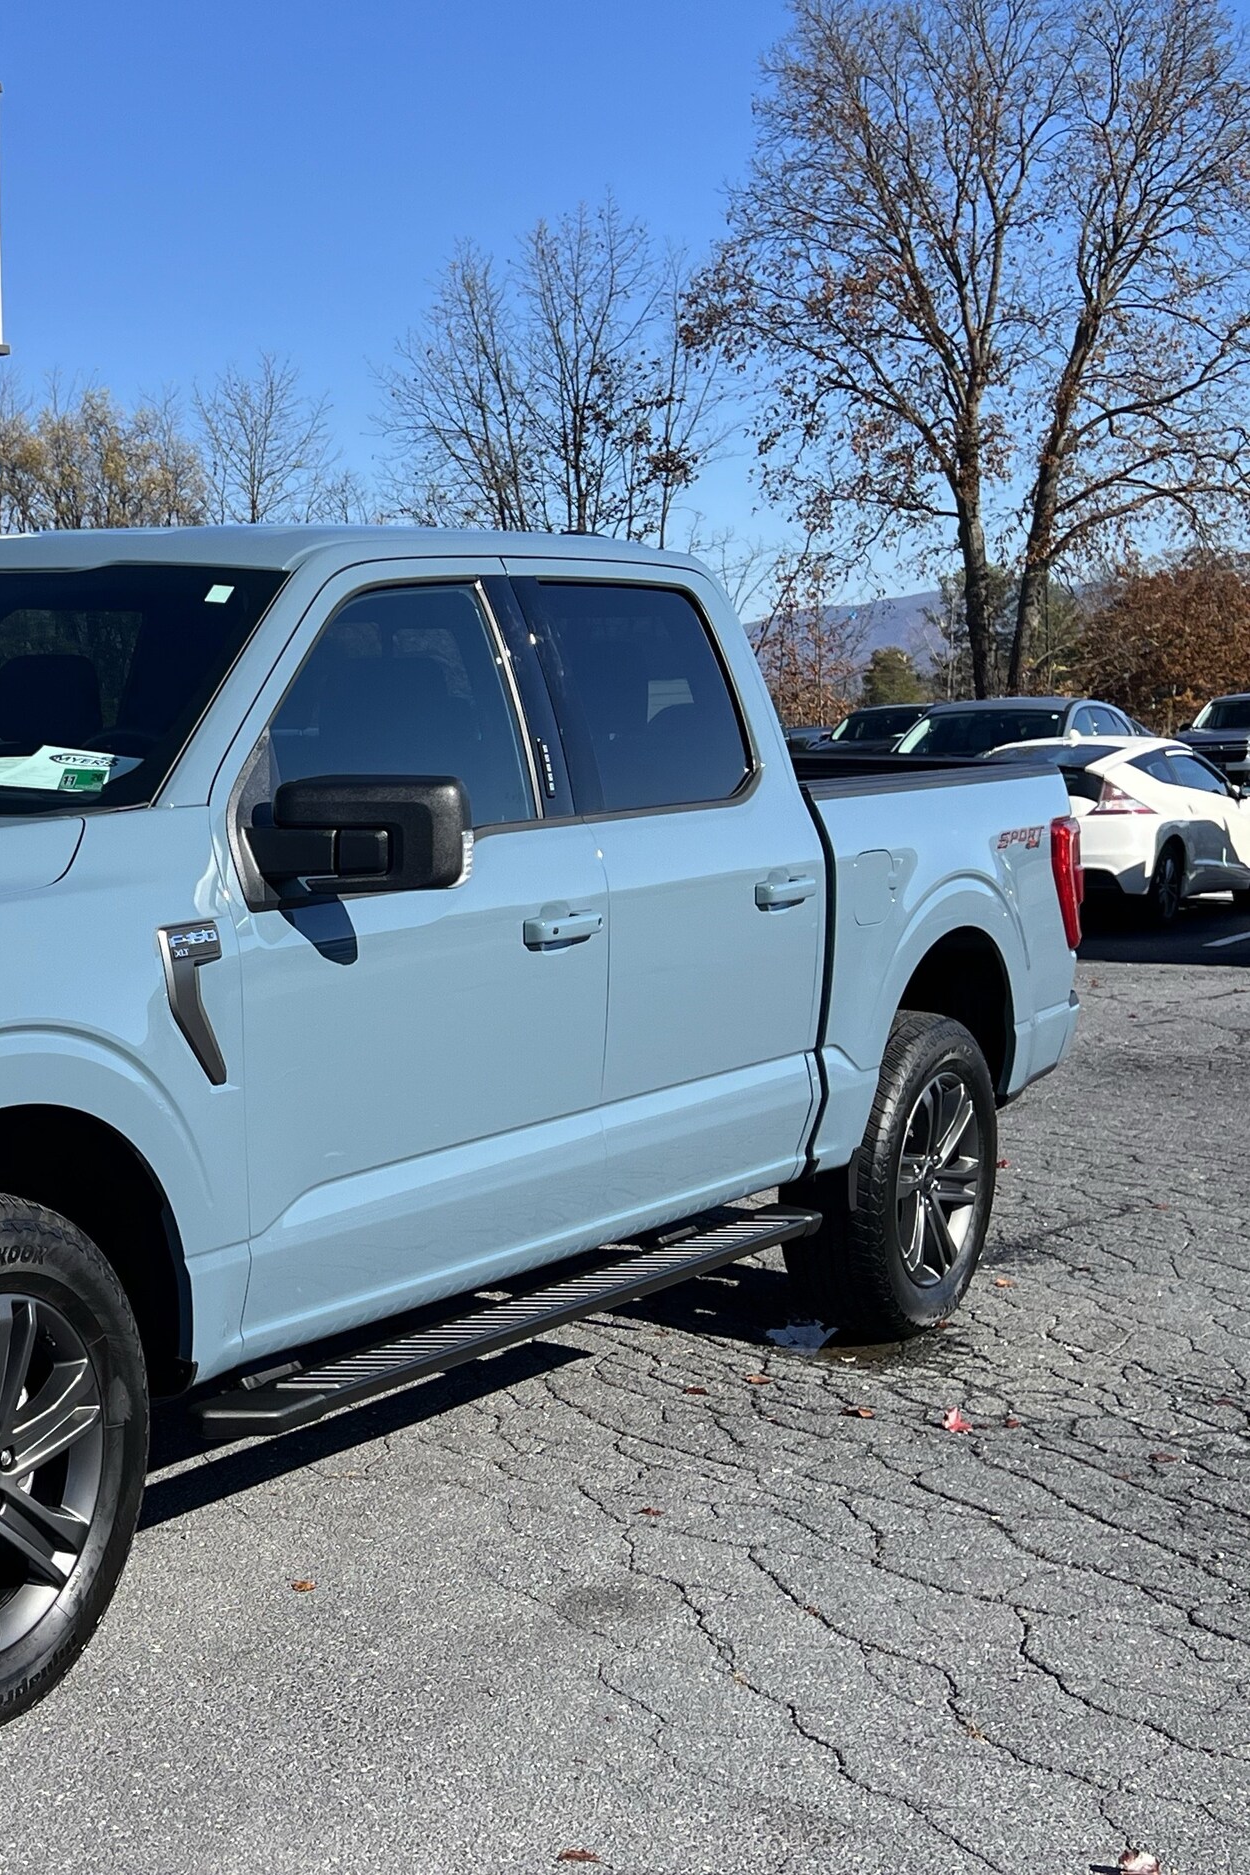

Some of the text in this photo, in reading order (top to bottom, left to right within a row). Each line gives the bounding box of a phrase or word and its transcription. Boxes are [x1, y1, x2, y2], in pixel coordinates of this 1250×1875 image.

[53, 753, 119, 767] MYERS
[63, 775, 76, 786] 11
[997, 825, 1045, 850] SPORT
[169, 929, 218, 948] F-150
[173, 948, 190, 959] XLT
